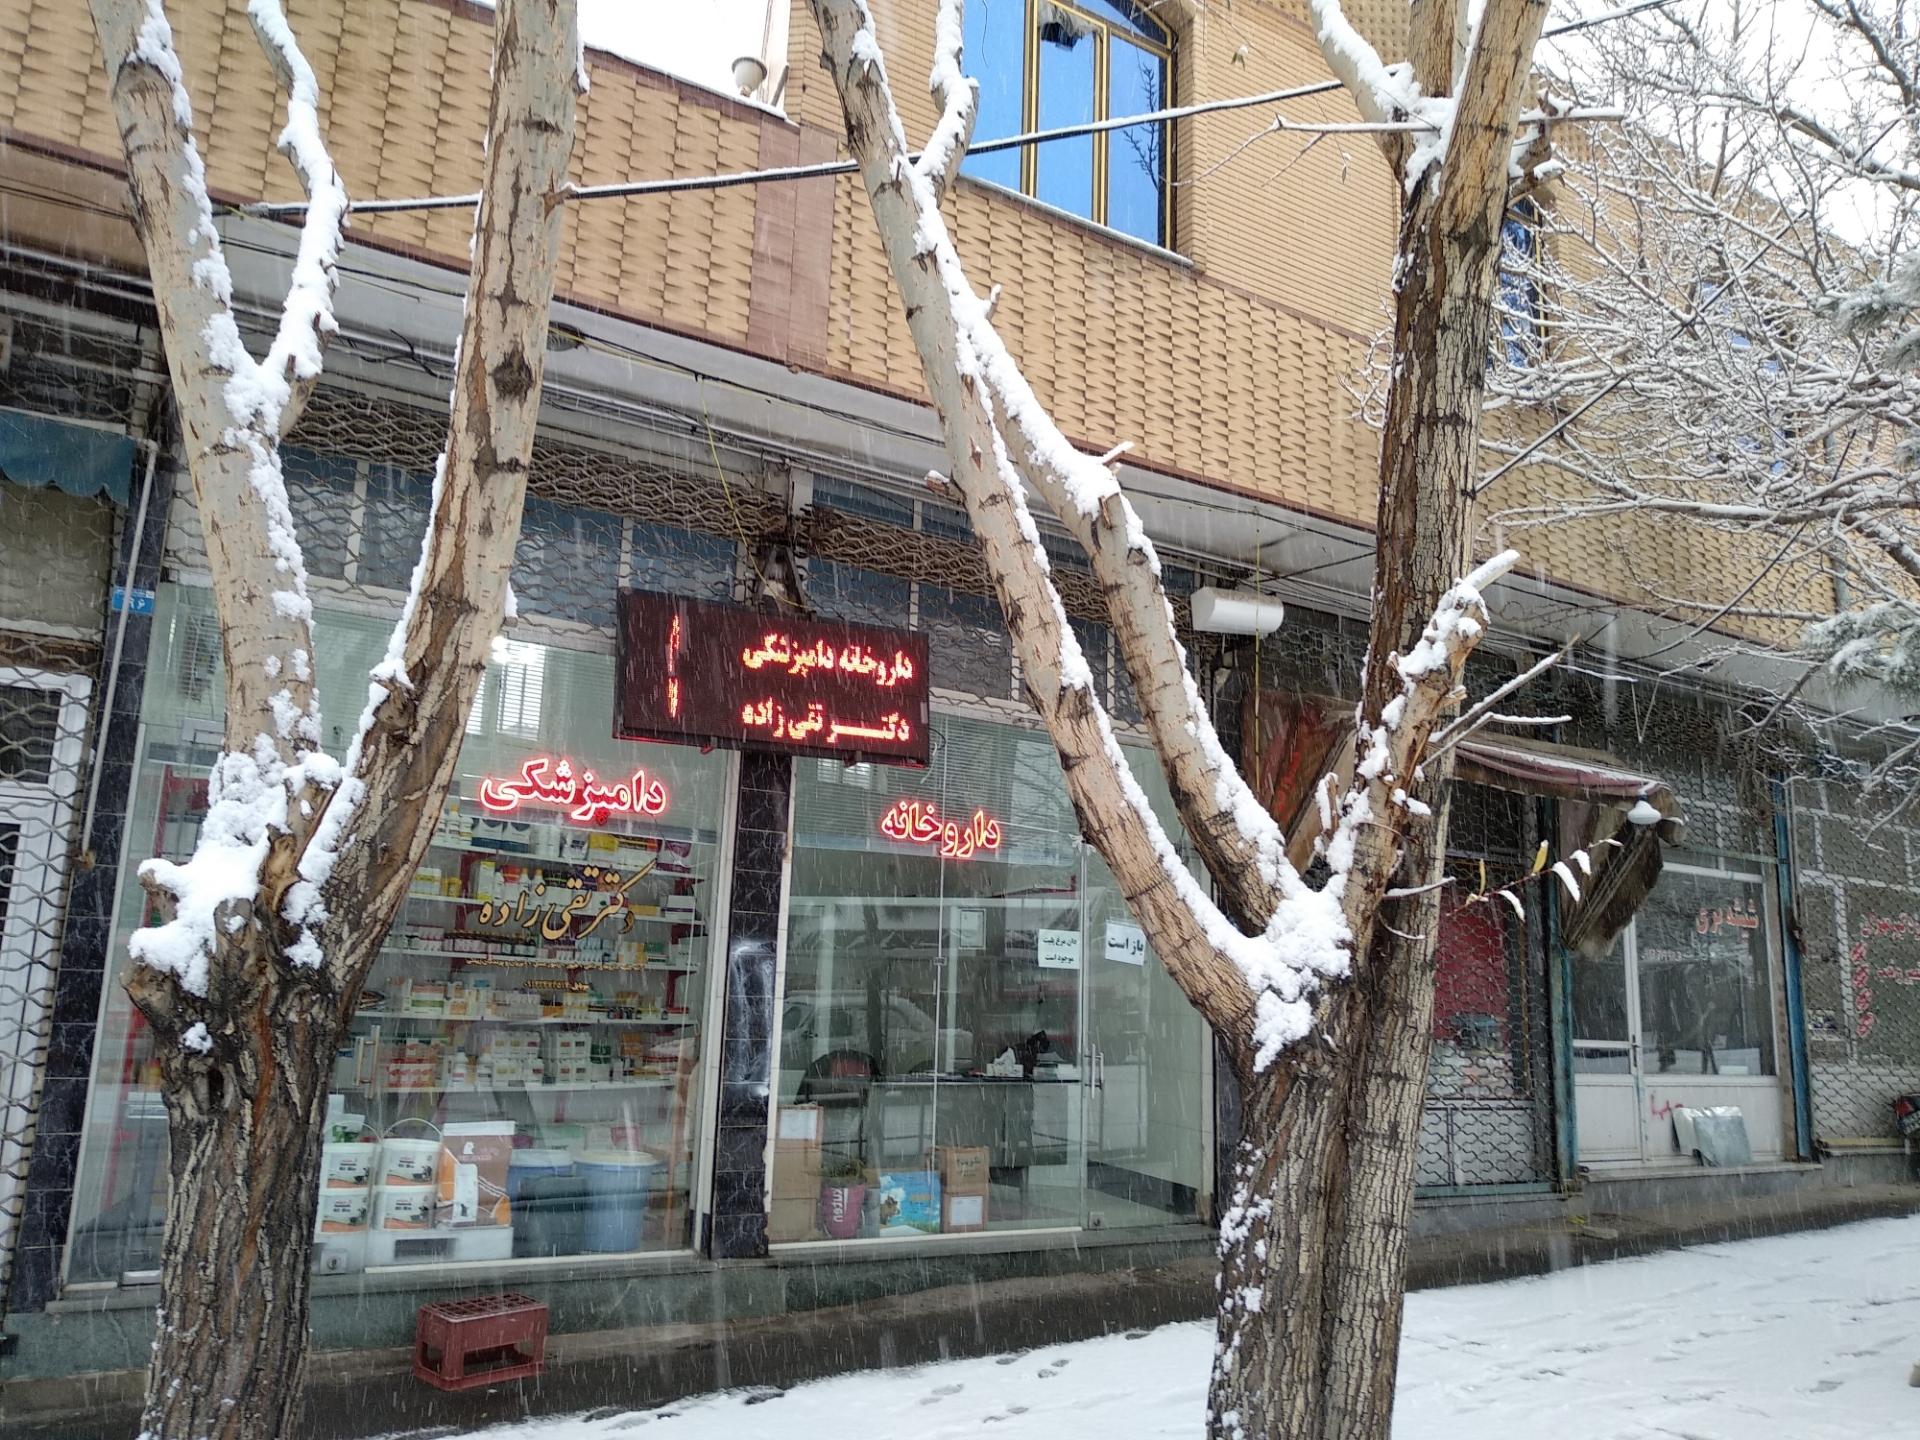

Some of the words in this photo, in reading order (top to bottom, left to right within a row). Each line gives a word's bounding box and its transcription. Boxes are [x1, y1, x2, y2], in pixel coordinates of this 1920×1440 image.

[743, 633, 835, 678] دامپزشکی
[839, 645, 913, 686] داروخانه
[742, 696, 784, 738] زاده
[788, 703, 823, 740] تقی
[480, 758, 667, 826] دامپزشکی
[881, 801, 1000, 858] داروخانه
[478, 883, 546, 928] زاده
[541, 864, 600, 940] تقی
[575, 858, 658, 939] دکتر
[1044, 953, 1057, 961] است
[1108, 937, 1129, 949] است
[1131, 938, 1144, 955] باز
